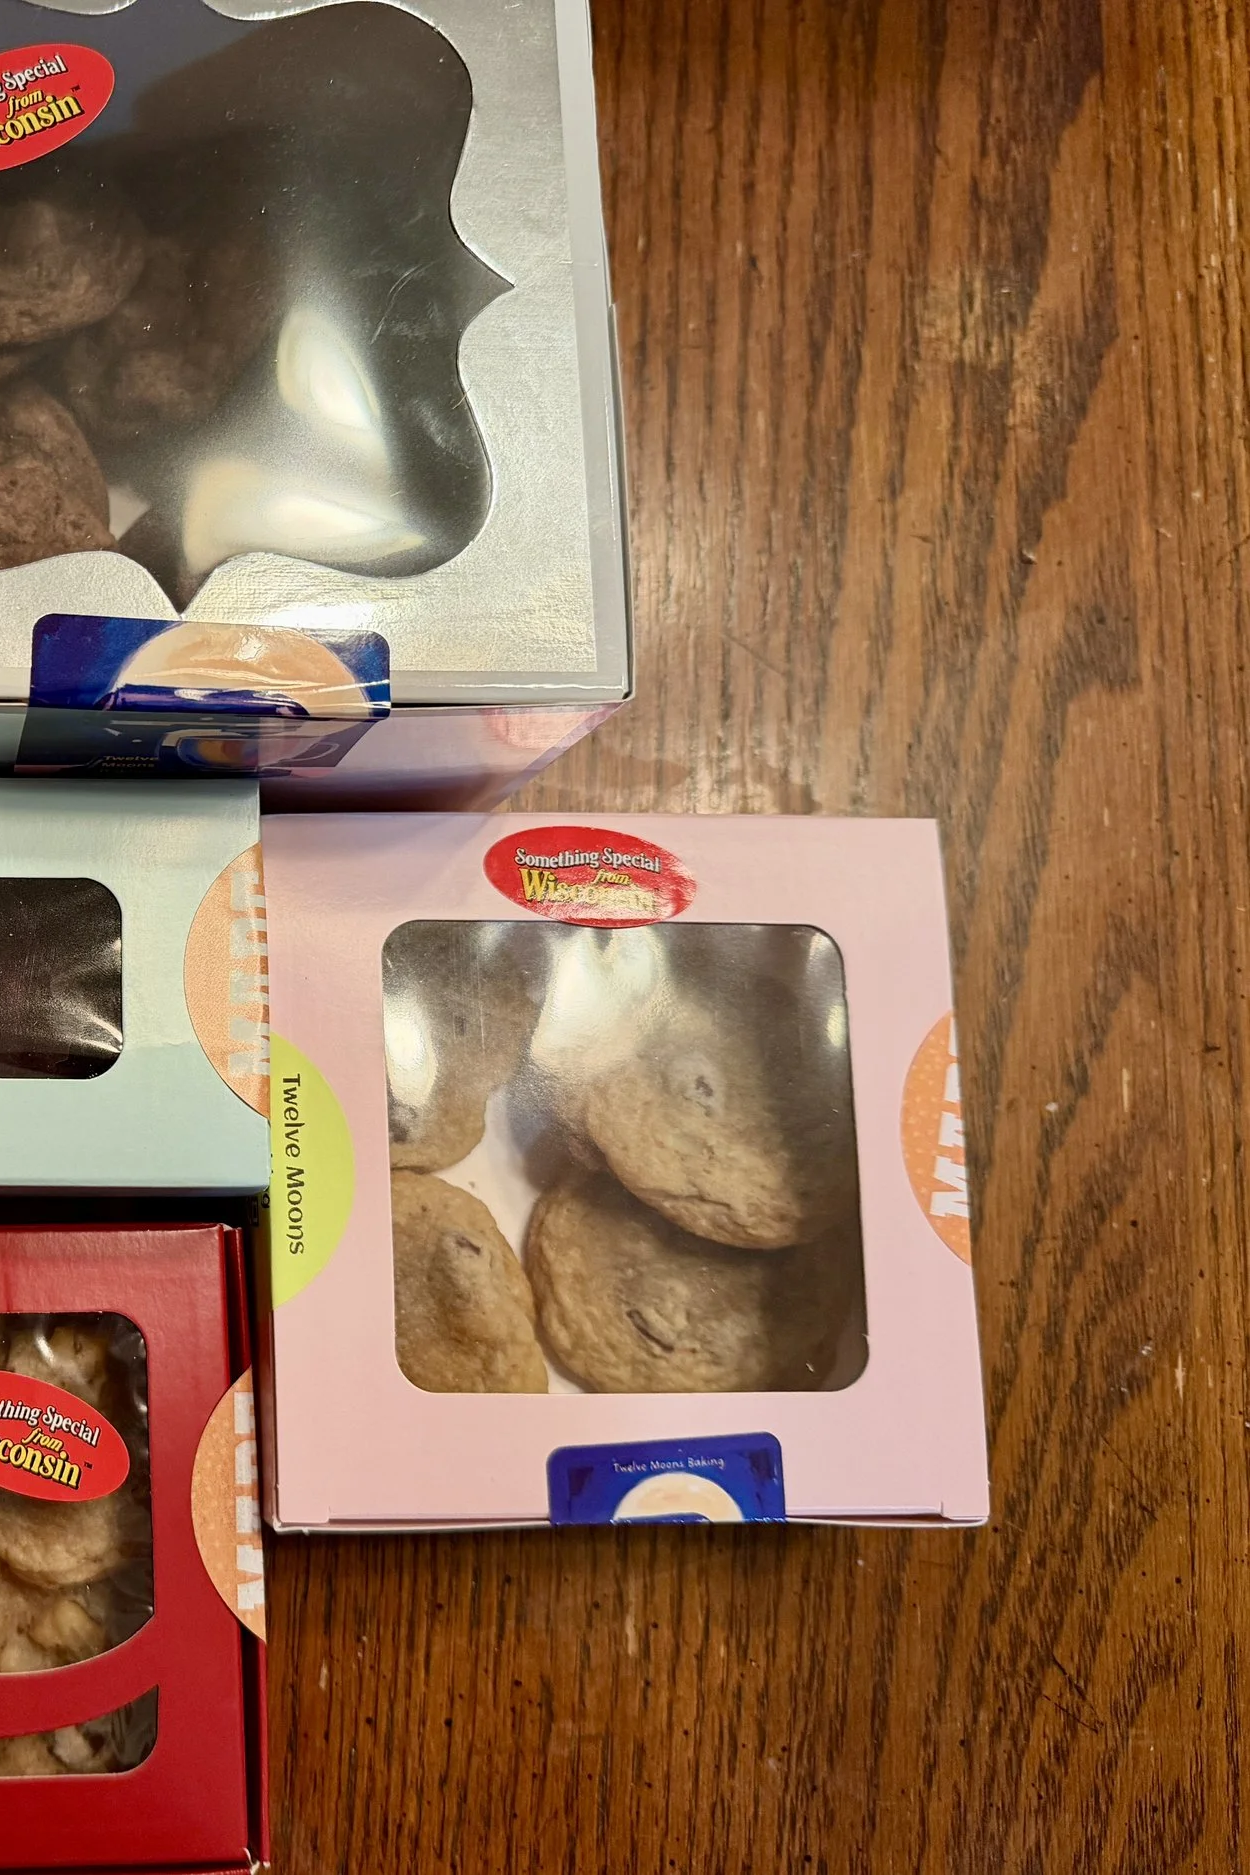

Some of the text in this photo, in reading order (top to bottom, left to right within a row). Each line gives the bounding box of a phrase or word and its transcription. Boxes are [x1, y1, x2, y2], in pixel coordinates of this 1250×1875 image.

[3, 54, 68, 91] Special
[6, 89, 44, 119] from
[514, 847, 661, 873] Something Special
[593, 869, 631, 886] from
[282, 1074, 306, 1256] Twelve Moons
[21, 1427, 63, 1453] from
[42, 1405, 101, 1447] Special
[687, 1457, 726, 1470] Baking
